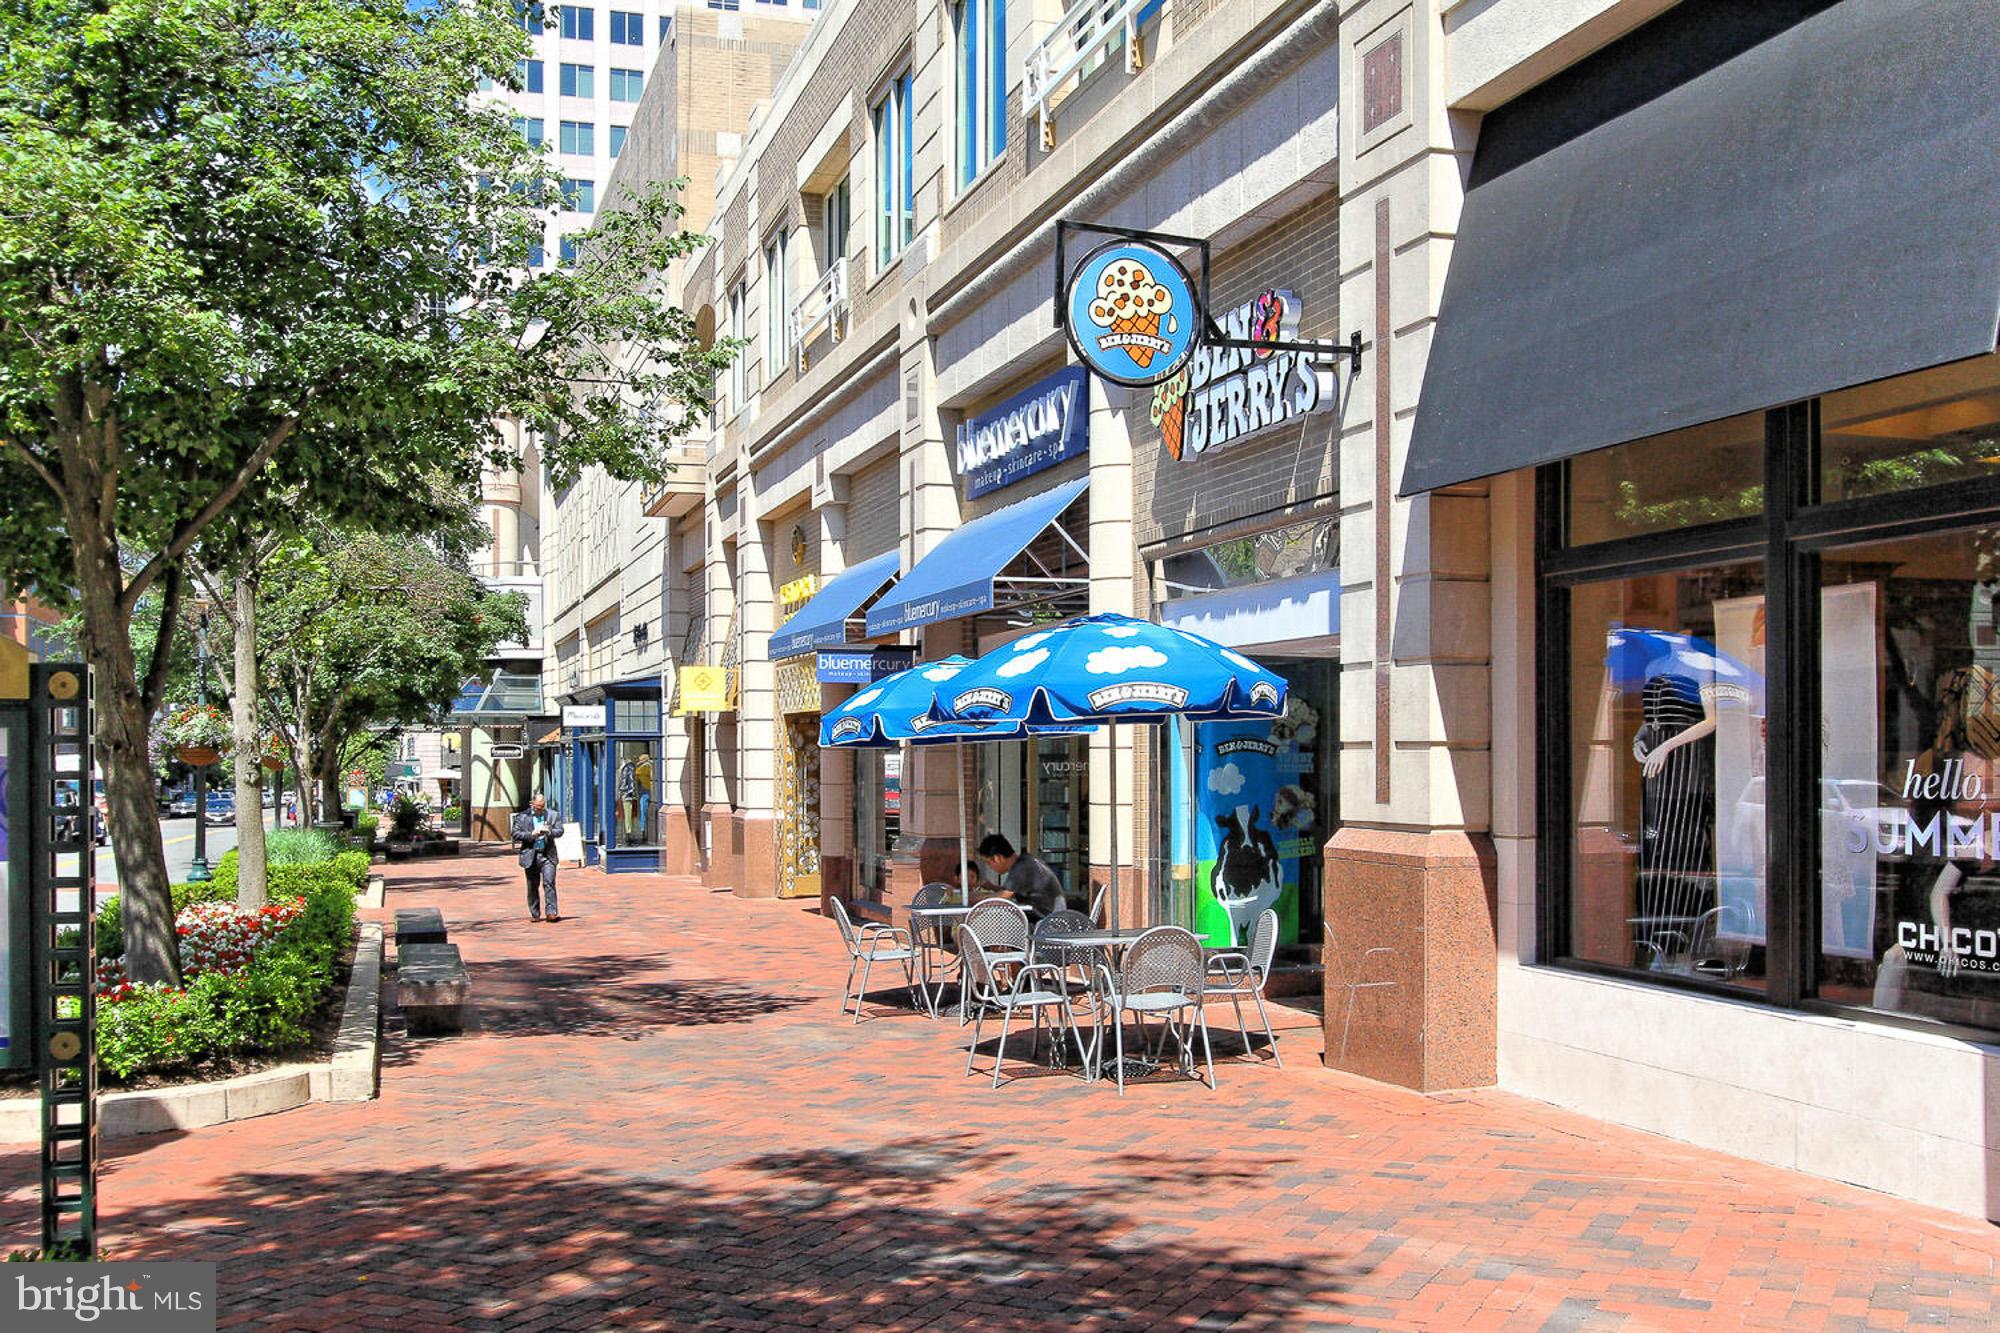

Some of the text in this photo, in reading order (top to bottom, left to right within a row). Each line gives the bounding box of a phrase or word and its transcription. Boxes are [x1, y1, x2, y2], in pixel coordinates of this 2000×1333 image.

[1192, 348, 1318, 453] JERRY'S
[819, 653, 911, 671] bluemercury
[1902, 758, 1987, 809] hello,
